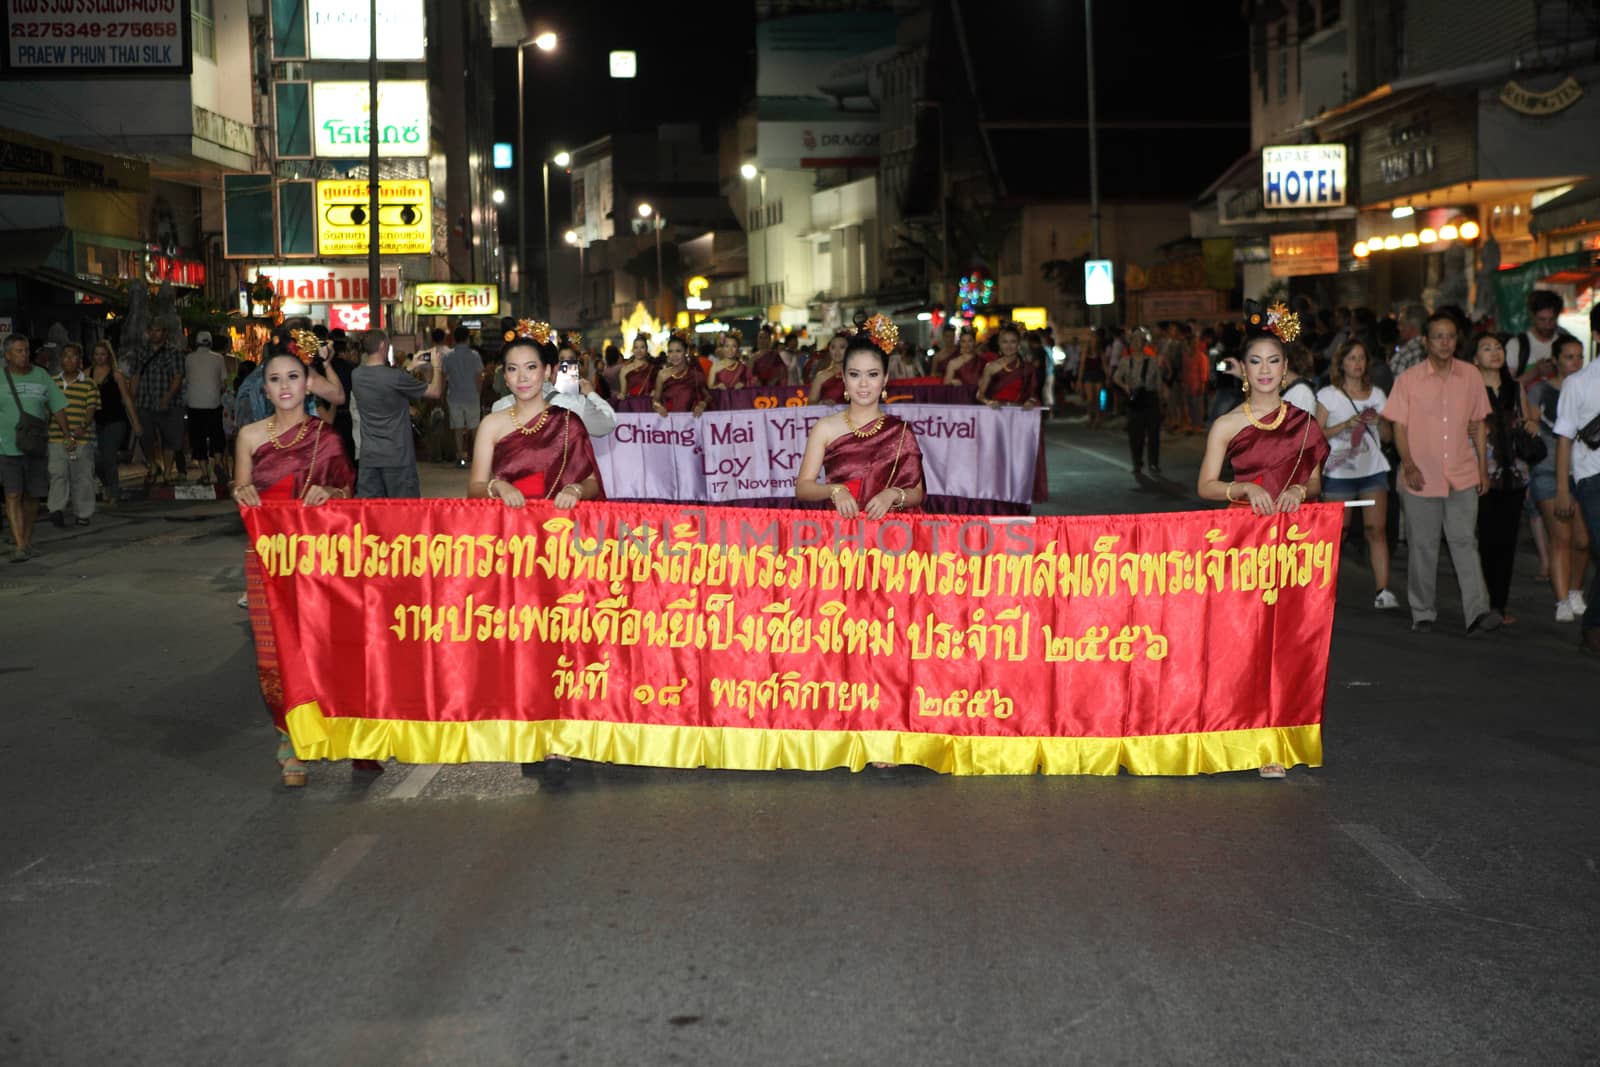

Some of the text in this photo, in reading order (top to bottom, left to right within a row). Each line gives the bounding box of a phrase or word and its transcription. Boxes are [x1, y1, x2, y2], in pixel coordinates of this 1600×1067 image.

[18, 45, 171, 64] PRAEW PHUN THAI SILK
[1266, 168, 1342, 205] HOTEL
[614, 415, 976, 447] Chiang Mai Yi-P stival
[767, 448, 802, 471] Kr
[711, 481, 729, 495] 17
[906, 605, 1031, 662] ประจำปี
[1042, 624, 1169, 663] ๒๕๕๖
[551, 651, 1015, 720] วันที่ ๑๘ พฤศจิกายน ๒๕๕๖
